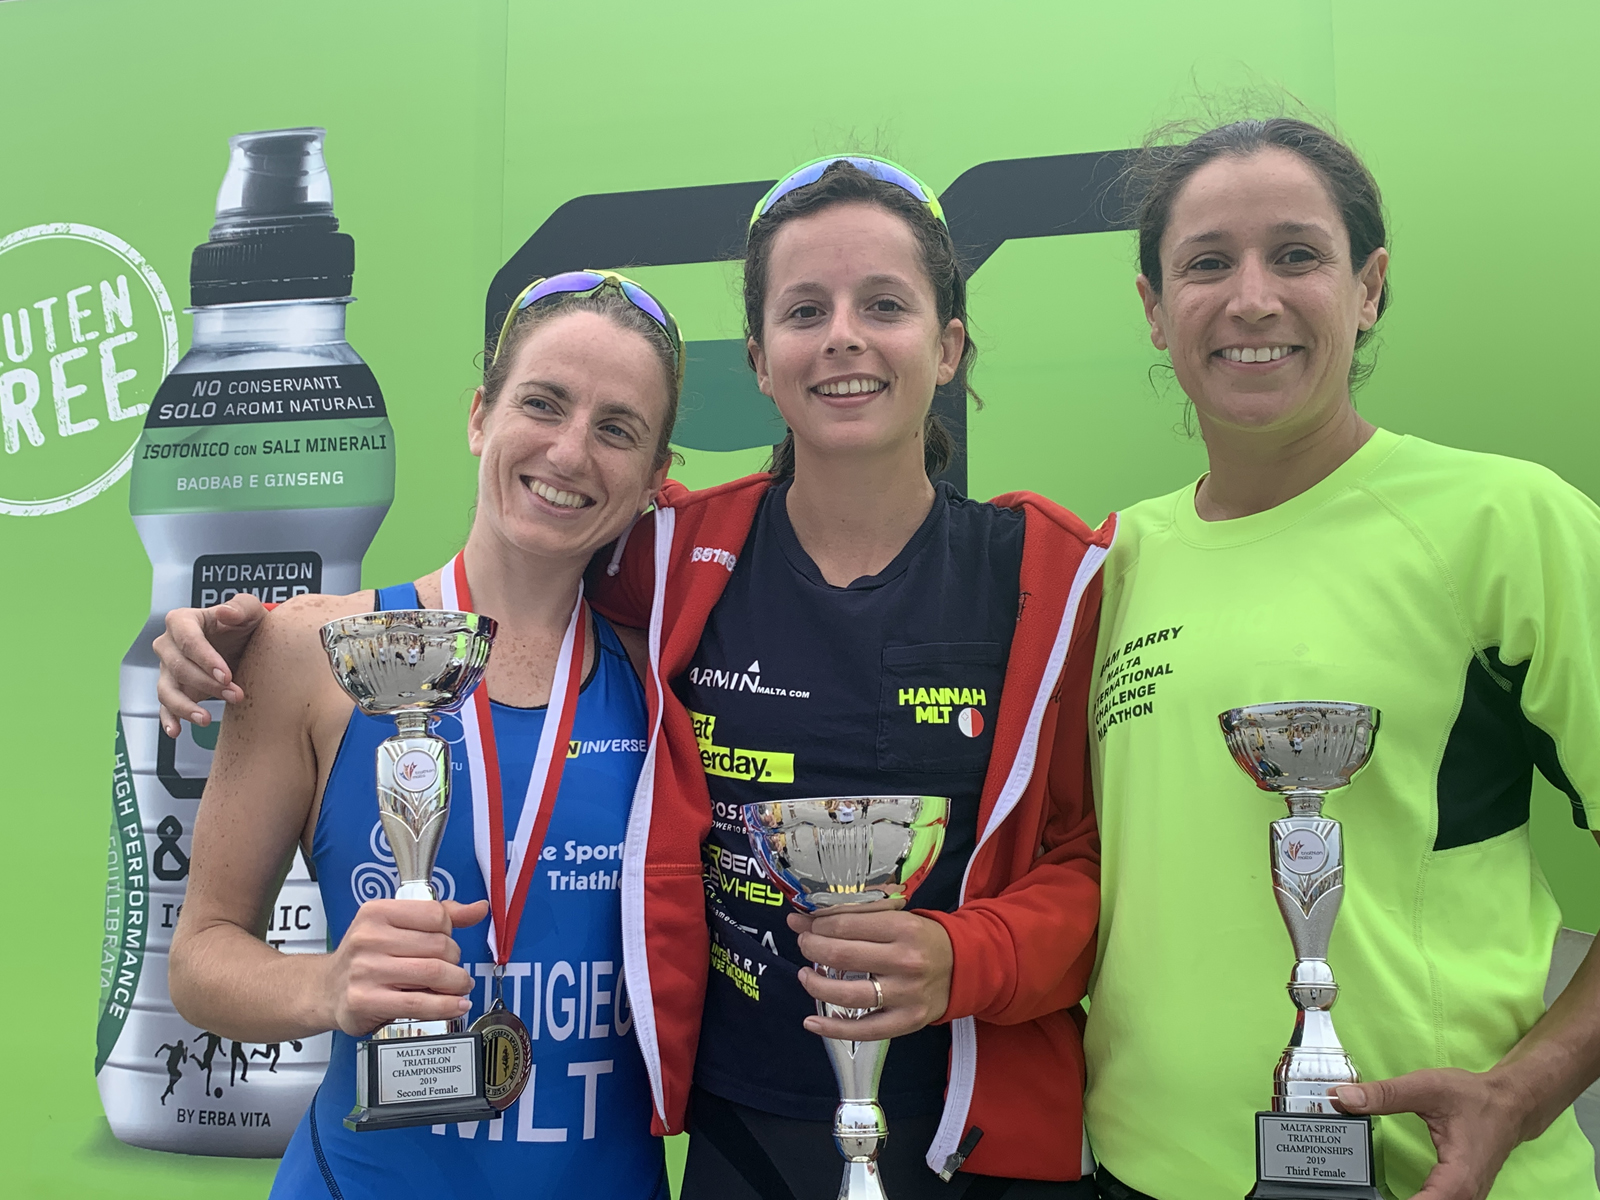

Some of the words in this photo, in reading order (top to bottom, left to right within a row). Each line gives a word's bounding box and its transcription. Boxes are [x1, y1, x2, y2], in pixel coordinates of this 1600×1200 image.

[0, 275, 133, 367] UTEN
[192, 380, 222, 397] NO
[228, 376, 342, 394] CONSERVANTI
[159, 402, 217, 420] SOLO
[224, 401, 284, 416] AROMI
[289, 396, 375, 413] NATURALI
[142, 442, 230, 459] ISOTONICO
[263, 439, 301, 454] SALI
[306, 435, 387, 453] MINERALI
[177, 475, 243, 491] BAOBAB
[249, 475, 258, 488] E
[265, 471, 344, 487] GINSENG
[202, 562, 313, 582] HYDRATION
[1123, 625, 1184, 656] BARRY
[1106, 656, 1141, 683] MALTA
[899, 687, 987, 706] HANNAH
[1096, 683, 1156, 725] CHALLENGE
[916, 706, 953, 724] MLT
[1097, 701, 1153, 742] MAATHON
[582, 739, 647, 754] INVERSE
[698, 748, 772, 781] erday.
[113, 753, 134, 816] HIGH
[109, 822, 144, 1020] PERFORMANCE
[396, 1049, 426, 1058] MALTA
[427, 1046, 457, 1055] SPRINT
[403, 1056, 451, 1067] TRIATHLON
[392, 1065, 462, 1078] CHAMPIONSHIPS
[420, 1077, 438, 1085] 2019
[396, 1087, 427, 1098] Second
[429, 1085, 458, 1096] Female
[177, 1108, 195, 1124] BY
[199, 1110, 237, 1127] ERBA
[240, 1112, 271, 1128] VITA
[1280, 1123, 1313, 1133] MALTA
[1314, 1125, 1348, 1134] SPRINT
[1288, 1134, 1341, 1144] TRIATHLON
[1276, 1144, 1354, 1155] CHAMPIONSHIPS
[1306, 1156, 1326, 1165] 2019
[1285, 1166, 1310, 1176] Third
[1313, 1167, 1346, 1178] Female
